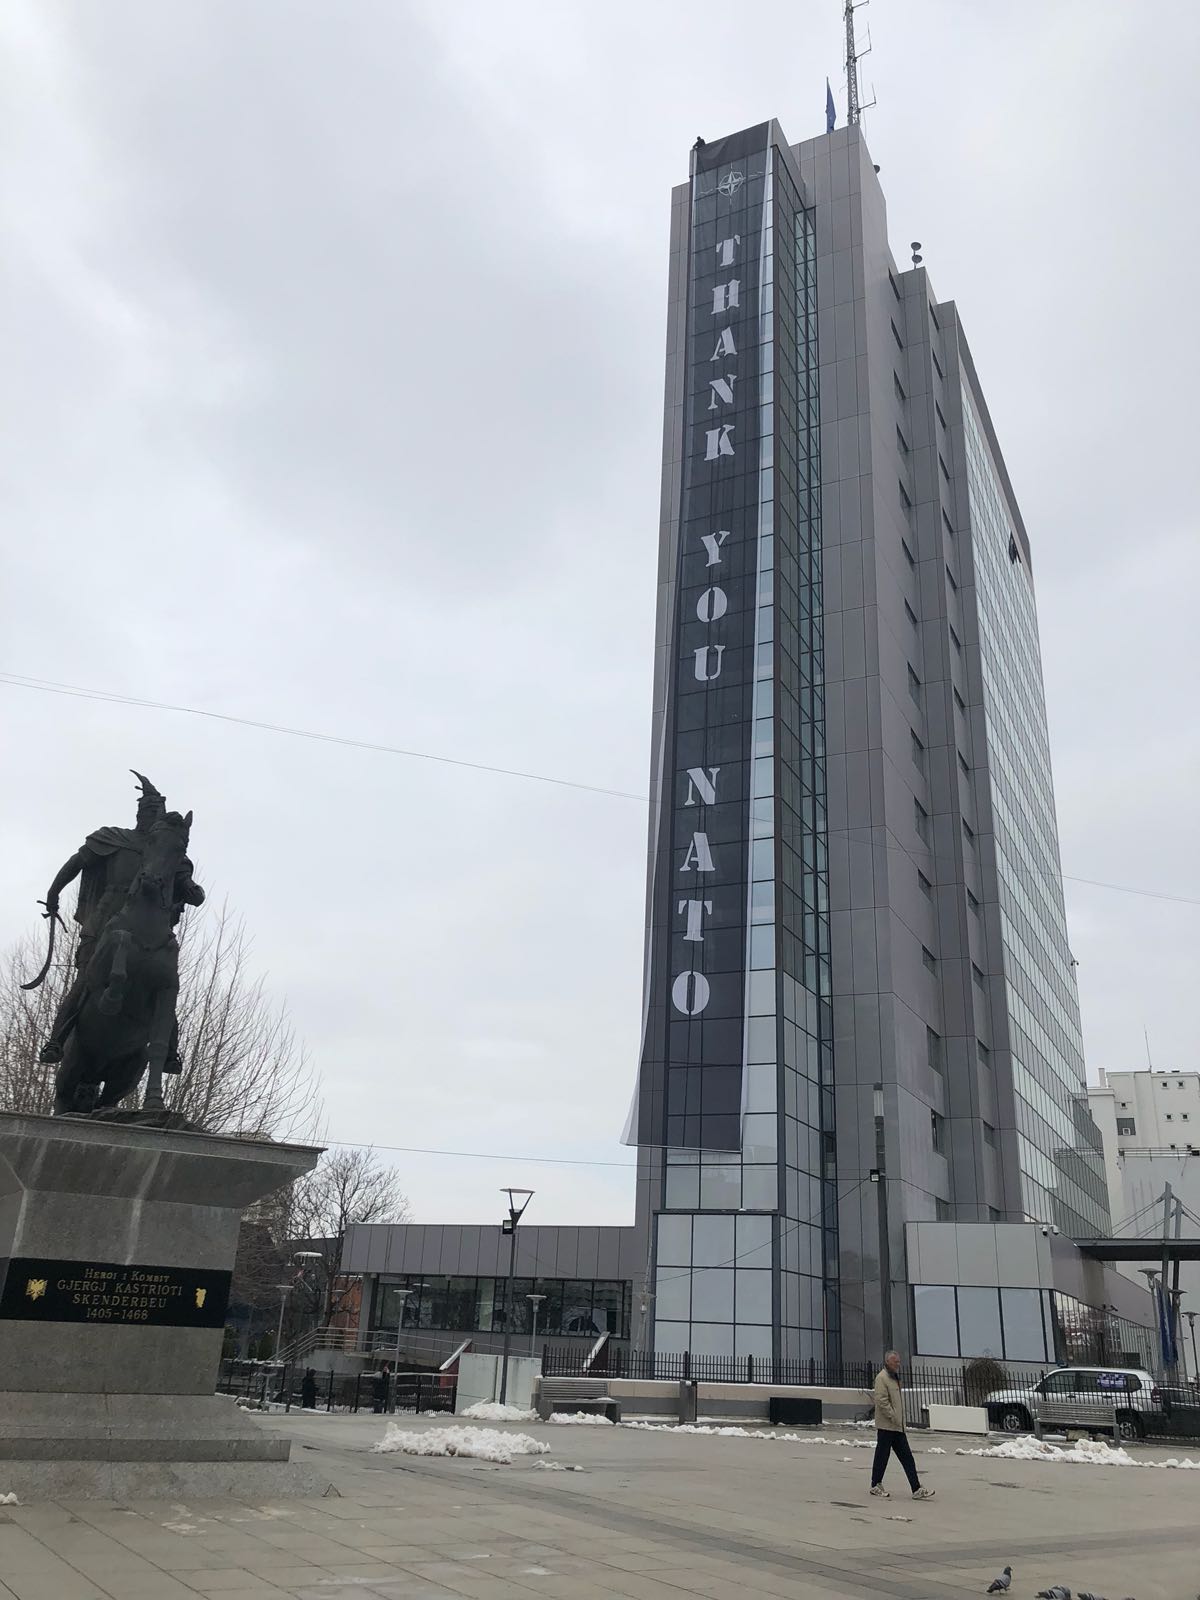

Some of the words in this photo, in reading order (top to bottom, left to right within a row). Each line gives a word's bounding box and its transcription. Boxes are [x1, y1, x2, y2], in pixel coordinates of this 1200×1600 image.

[703, 233, 741, 461] THANK
[694, 530, 731, 682] YOU
[671, 767, 721, 1016] NATO
[56, 1279, 107, 1292] GJERGJ
[114, 1283, 183, 1297] KASTRIOTI
[72, 1293, 167, 1308] SKENDERBEU
[86, 1307, 149, 1320] 1405-1468
